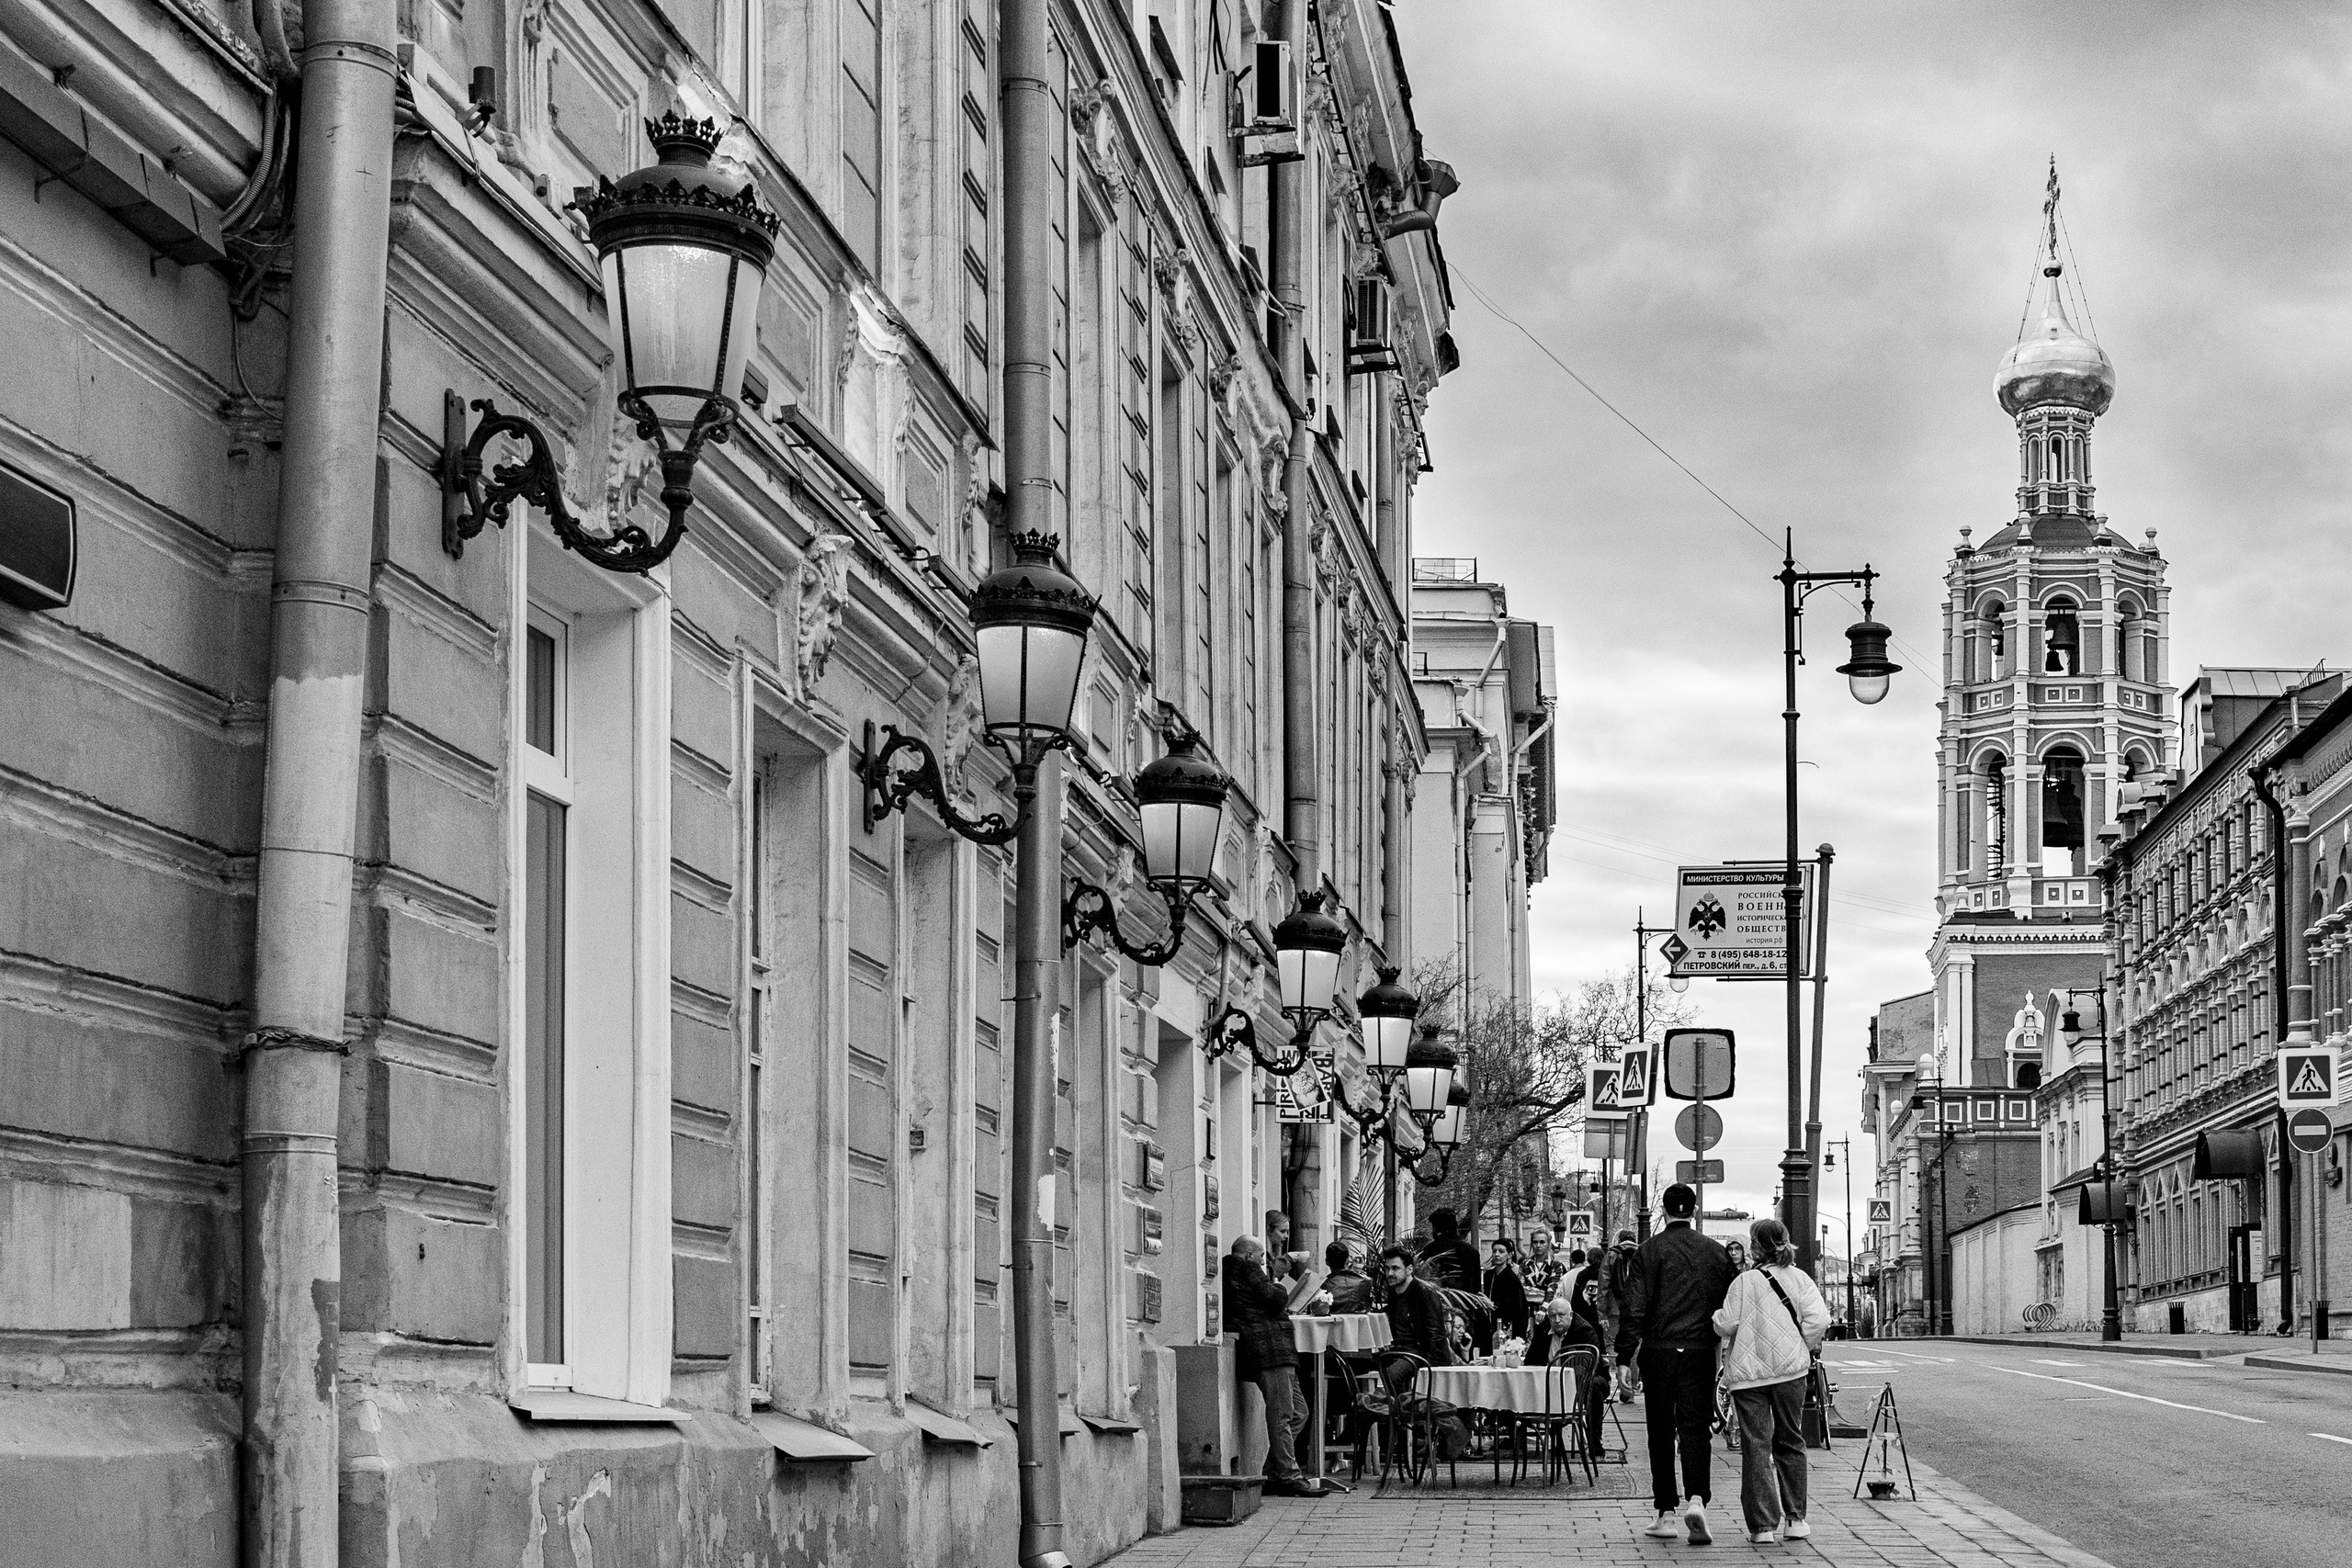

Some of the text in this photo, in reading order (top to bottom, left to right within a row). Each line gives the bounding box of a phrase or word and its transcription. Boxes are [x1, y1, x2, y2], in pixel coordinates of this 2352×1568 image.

[1687, 874, 1784, 883] МИНИСТЕРСТВО КУЛЬТУРЫ
[1746, 936, 1783, 944] история.рф
[1718, 951, 1741, 960] (495)
[1743, 950, 1788, 958] 648-18-12
[1683, 959, 1740, 970] ПЕТРОВСКИЙ
